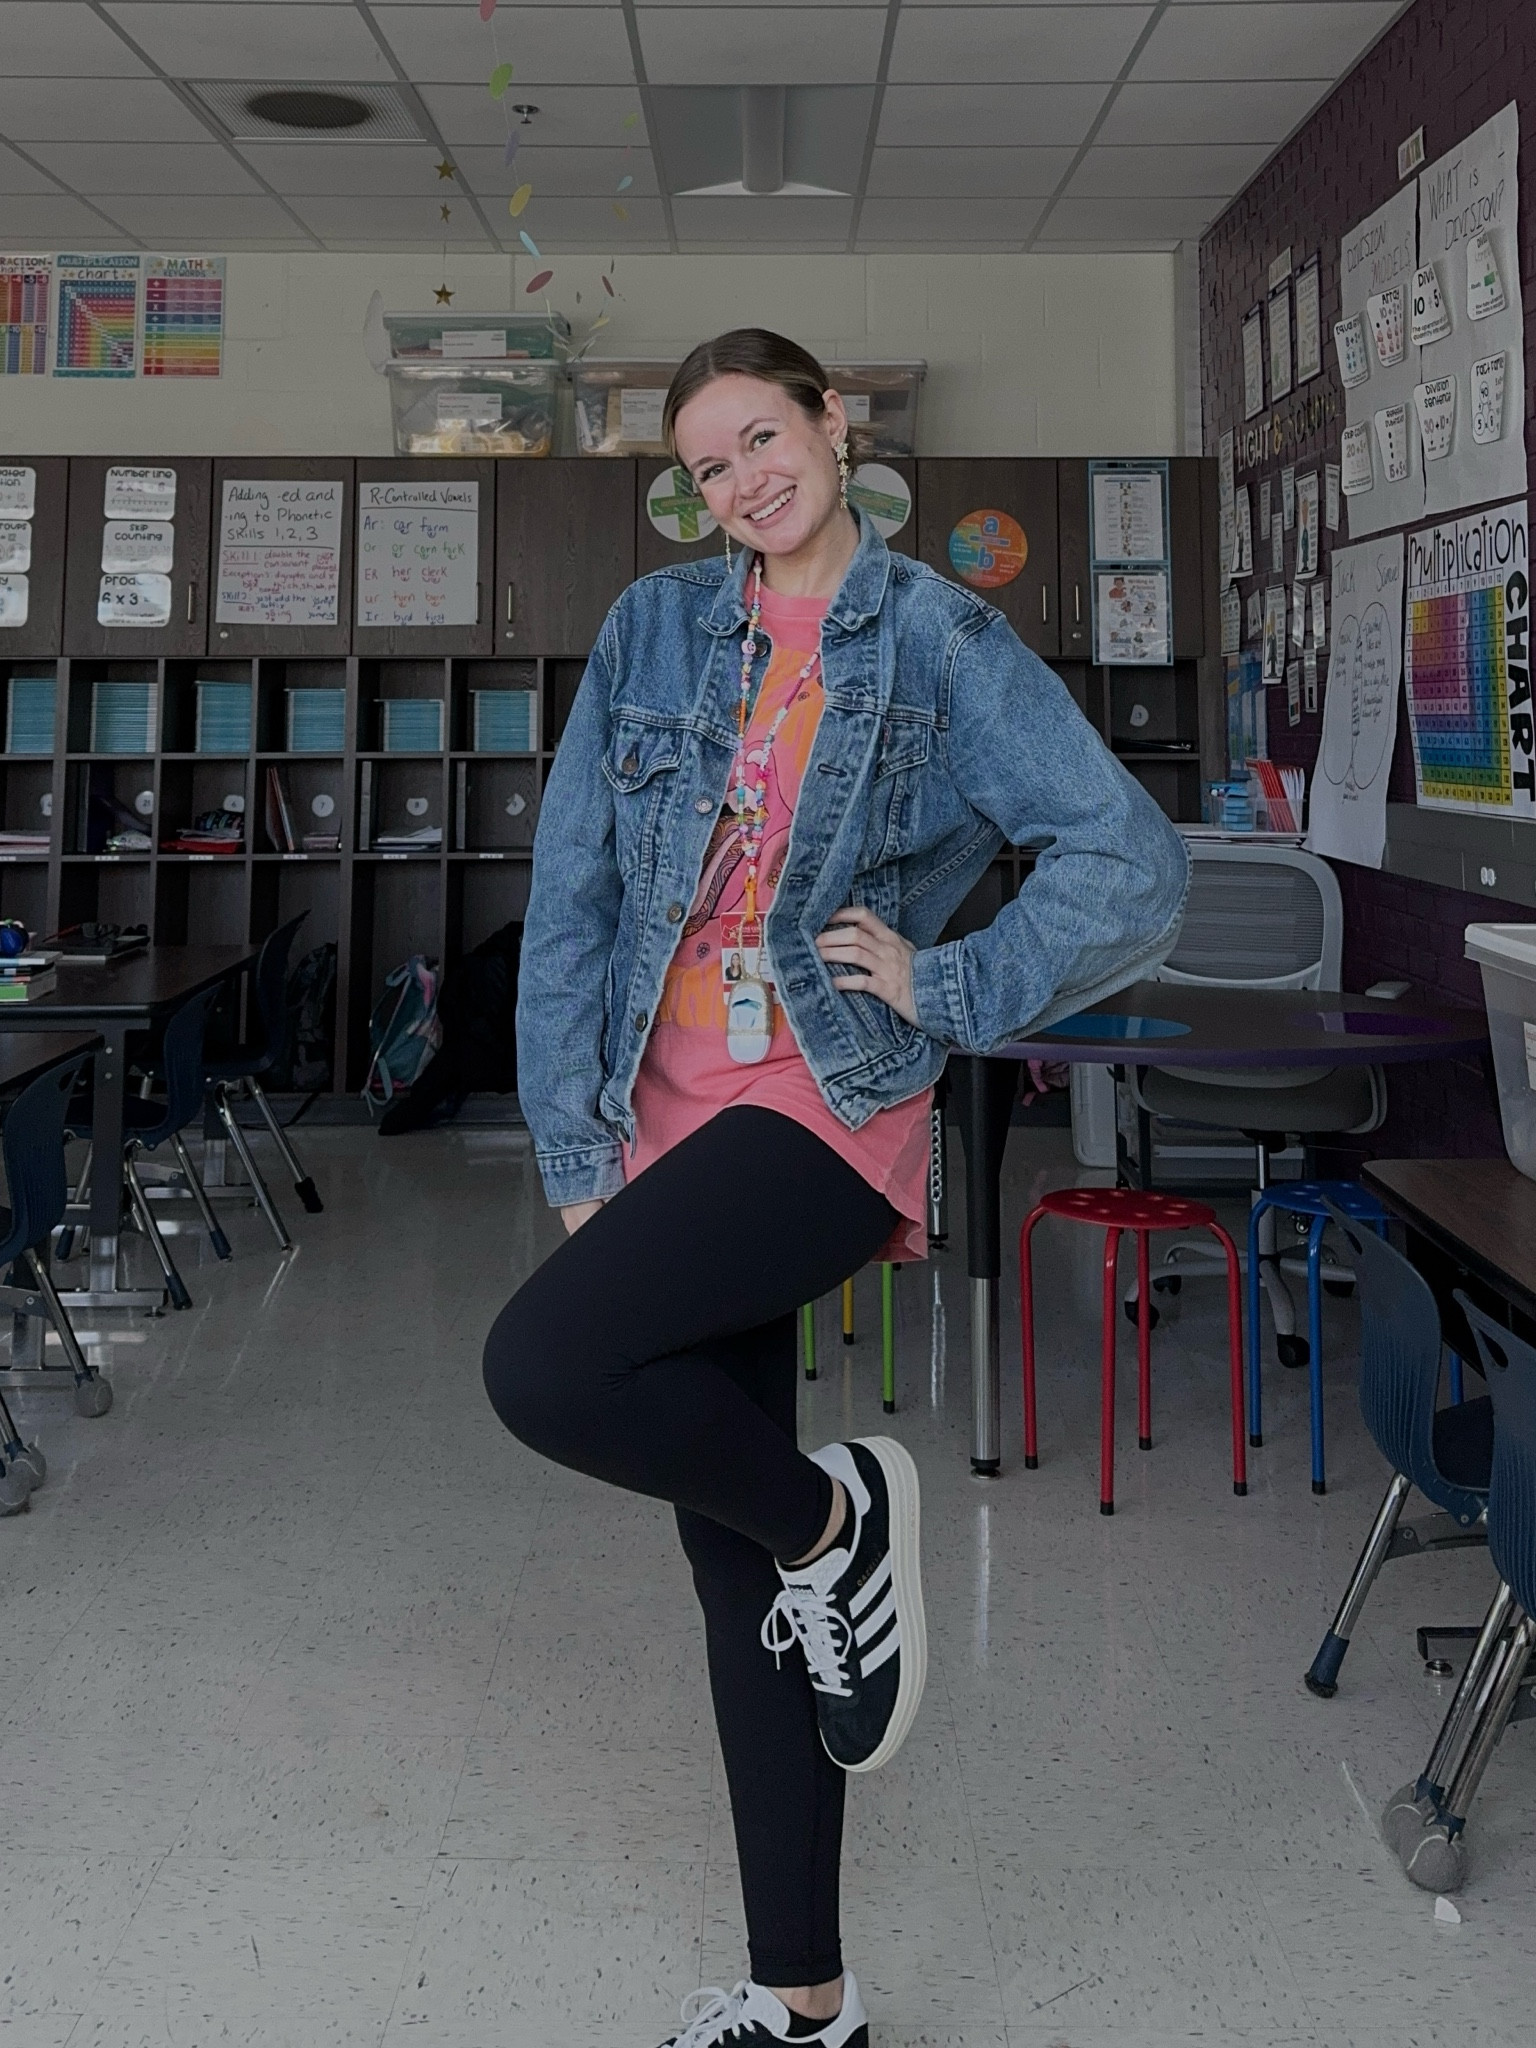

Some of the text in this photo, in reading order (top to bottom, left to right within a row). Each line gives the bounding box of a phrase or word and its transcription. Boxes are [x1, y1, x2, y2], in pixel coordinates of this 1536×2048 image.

[1428, 160, 1462, 221] WHAT
[1445, 179, 1504, 250] DIVISION?
[60, 257, 138, 267] MULTIPLICATION
[167, 258, 203, 270] MATH
[78, 267, 119, 279] chart
[163, 270, 206, 278] KEYWORDS
[1413, 296, 1426, 316] 10
[1433, 289, 1440, 308] 5
[1237, 420, 1271, 473] LIGHT
[228, 486, 335, 510] Adding -ed and
[370, 486, 473, 505] R-Controlled Vowels
[254, 511, 270, 523] to
[277, 508, 333, 522] Phonetic
[393, 519, 413, 532] car
[420, 516, 449, 533] farm
[307, 526, 318, 541] 3
[983, 515, 999, 535] a
[264, 550, 292, 560] double
[296, 550, 310, 560] the
[977, 545, 996, 571] b
[1409, 515, 1527, 592] Multiplication
[392, 565, 412, 577] her
[102, 592, 111, 604] 6
[129, 592, 138, 605] 3
[1505, 570, 1536, 803] CHART
